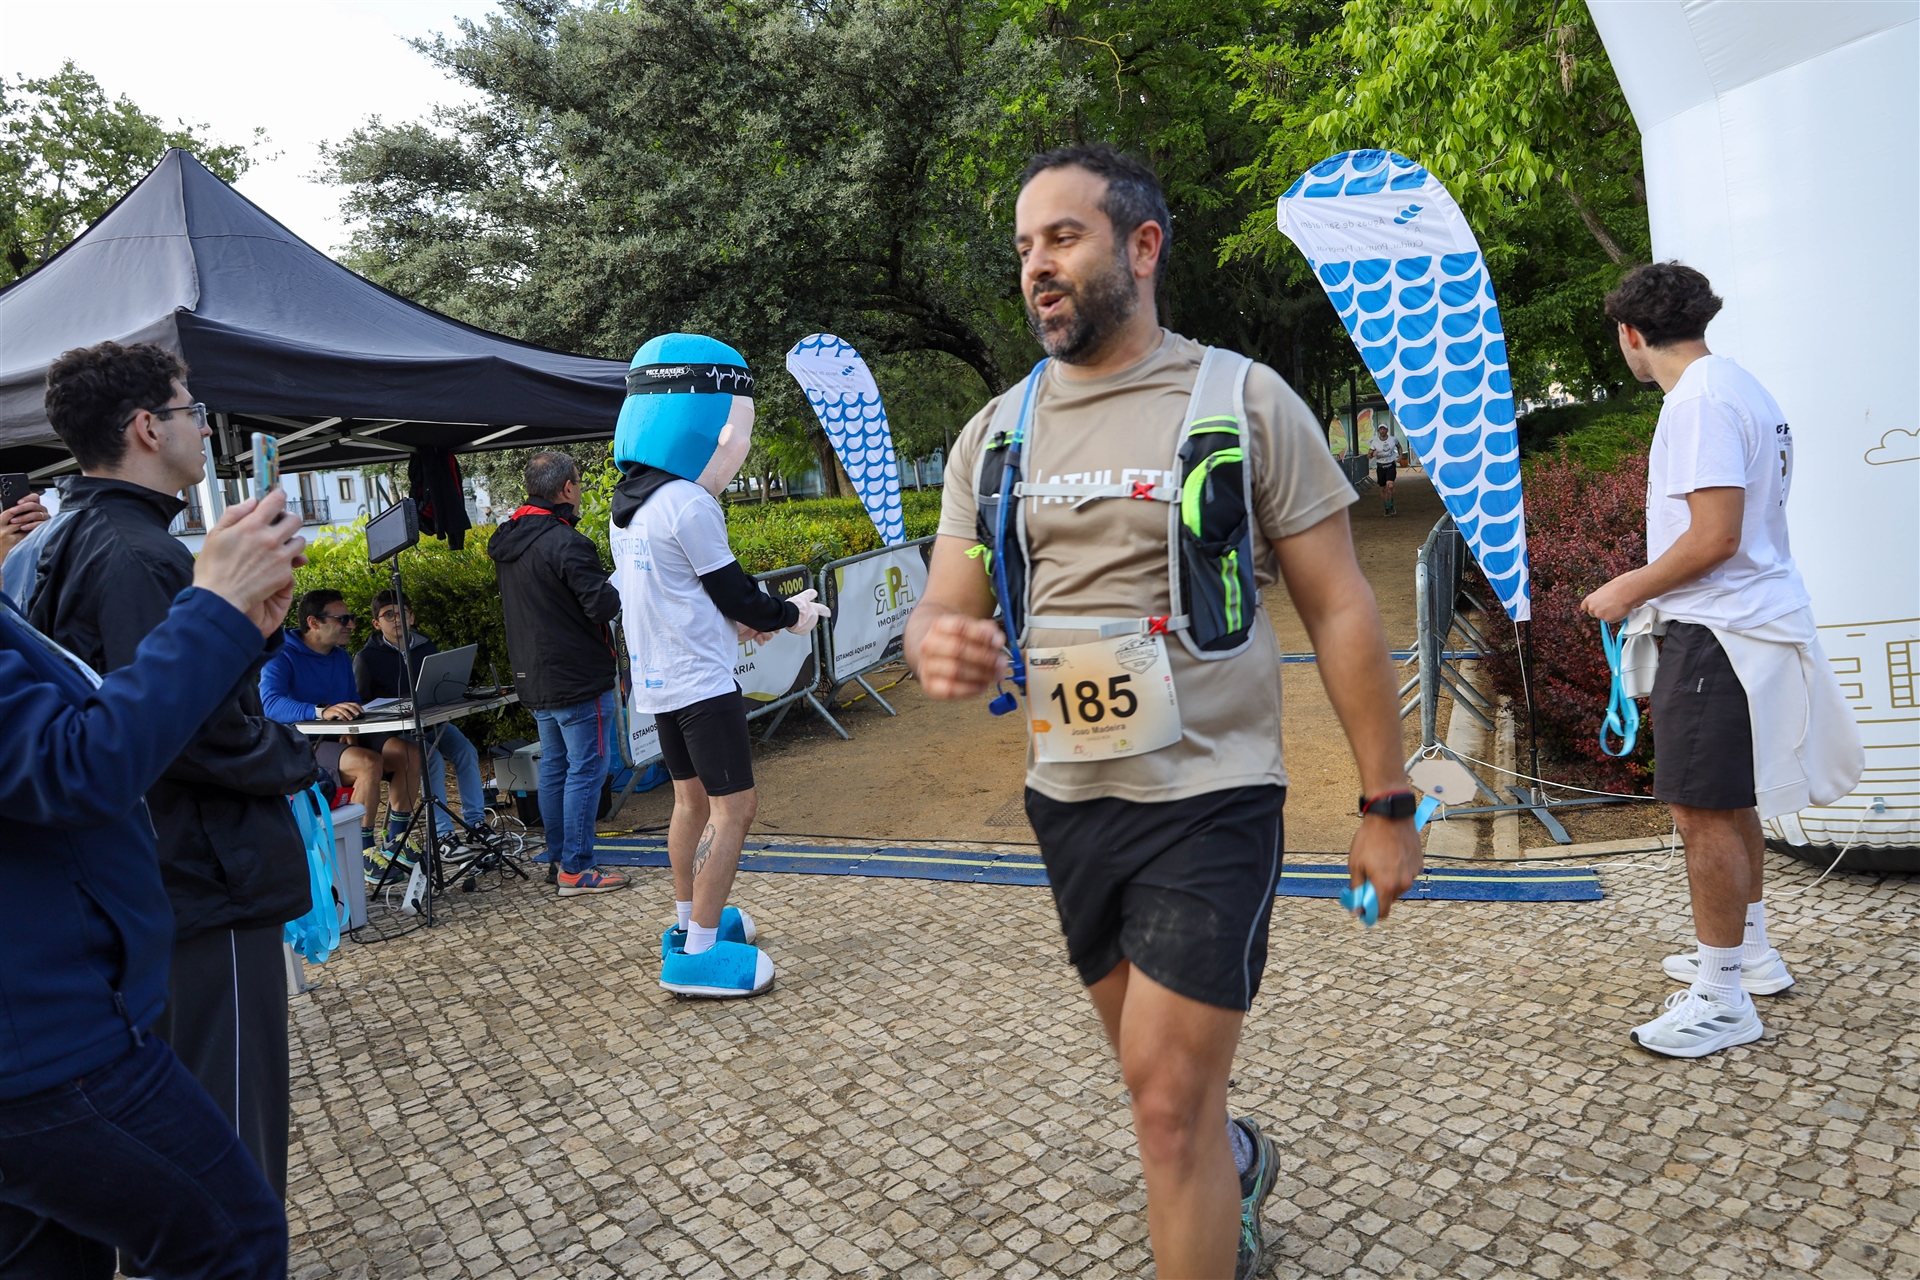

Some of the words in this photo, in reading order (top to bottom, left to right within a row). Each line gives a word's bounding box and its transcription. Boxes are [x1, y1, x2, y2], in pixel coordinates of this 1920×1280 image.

[634, 560, 651, 571] TRAIL
[778, 577, 804, 595] +1000
[1051, 673, 1138, 725] 185
[632, 723, 658, 741] ESTAMOS
[1091, 723, 1126, 734] Madeira
